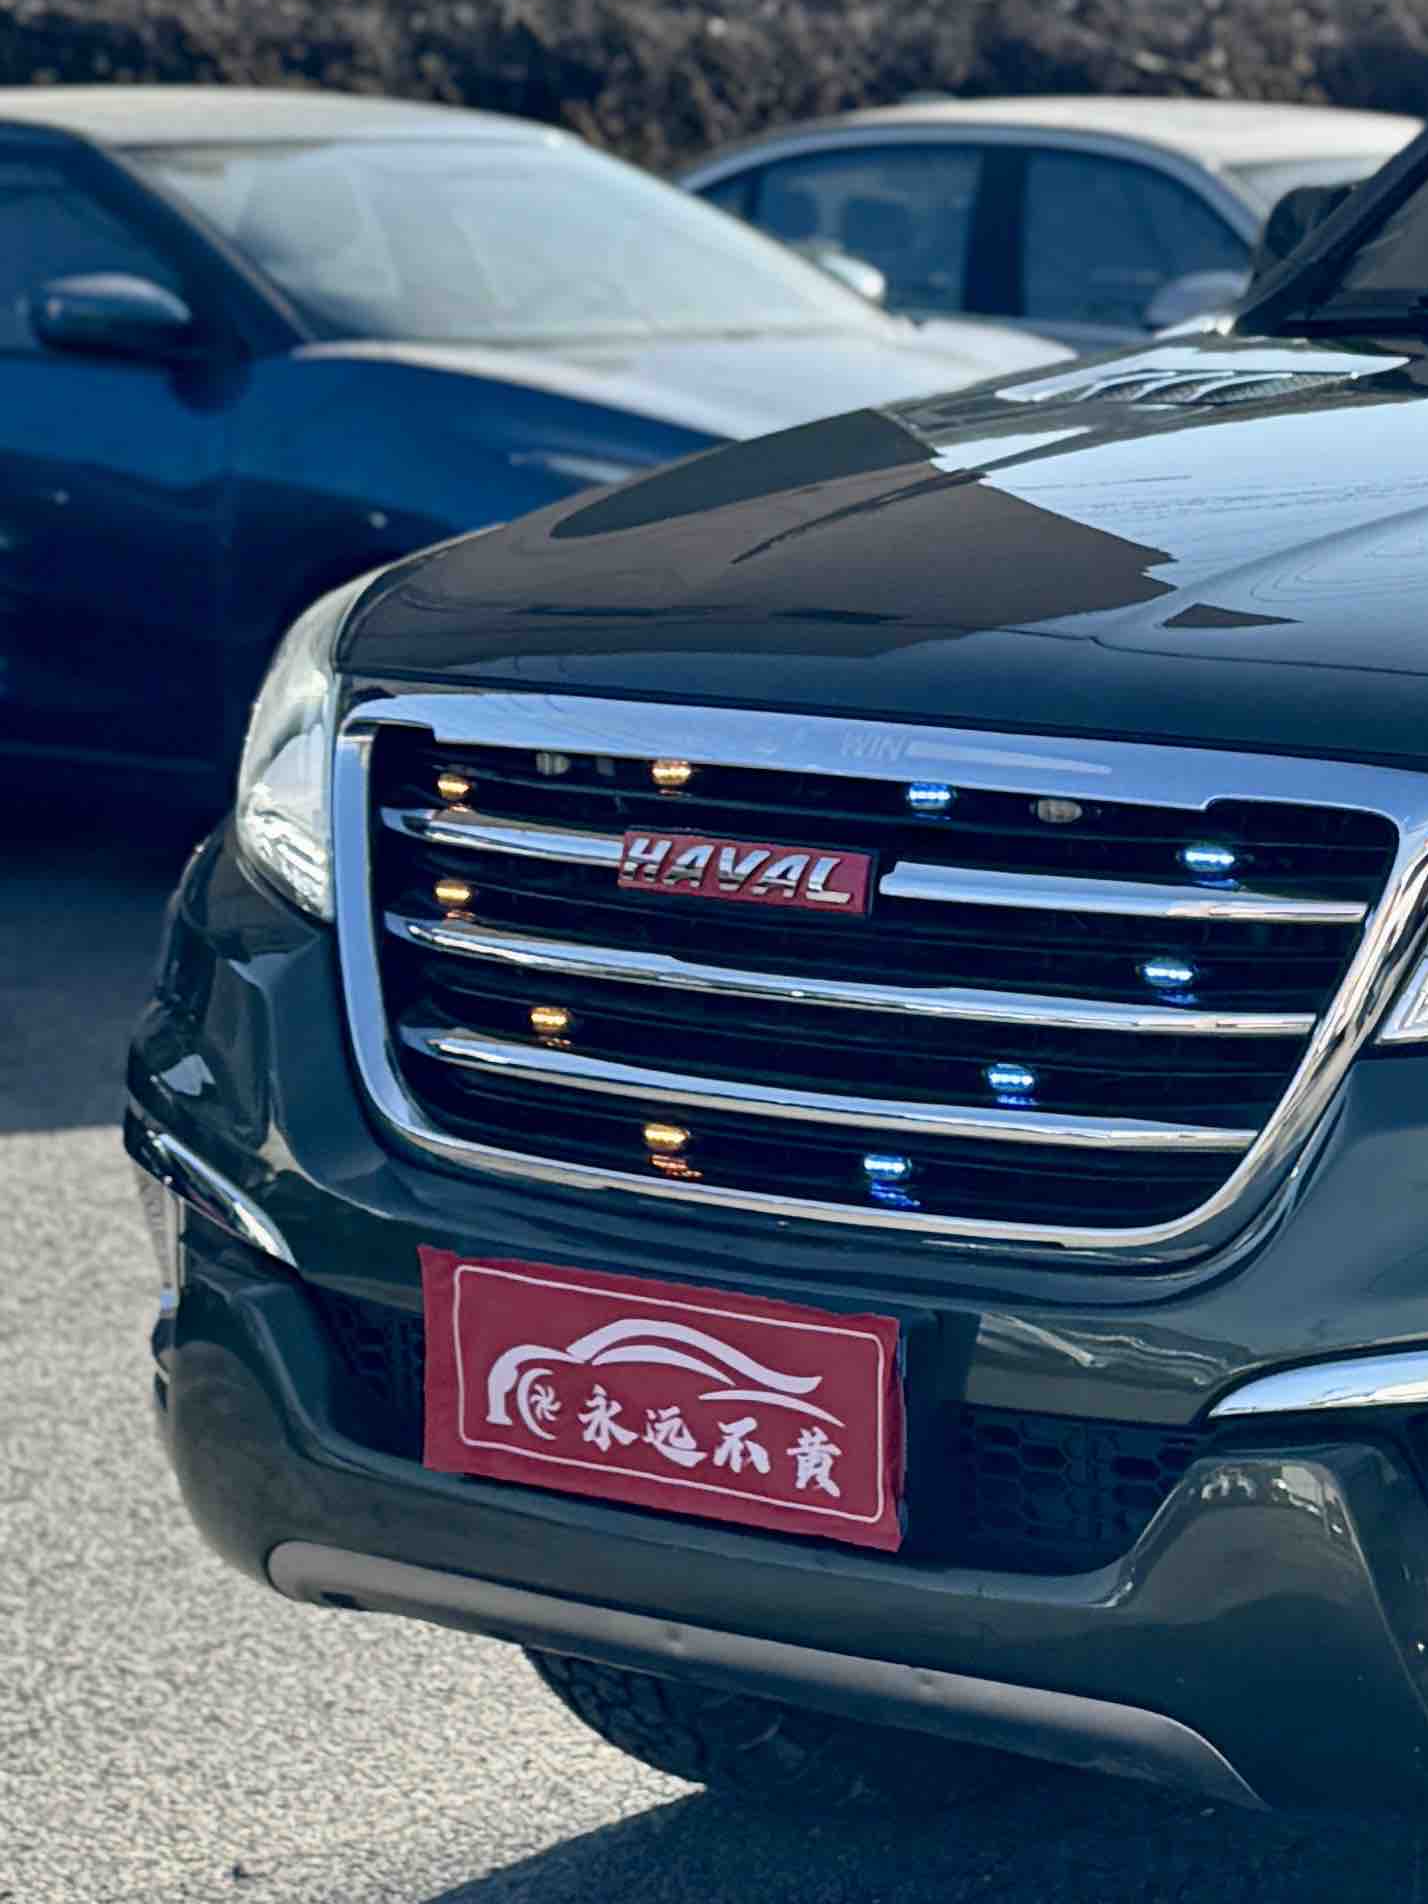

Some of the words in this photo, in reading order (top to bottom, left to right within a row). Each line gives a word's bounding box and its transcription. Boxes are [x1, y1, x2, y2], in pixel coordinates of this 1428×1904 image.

[617, 836, 853, 905] HAVAL
[576, 1383, 842, 1498] 永远不黄
